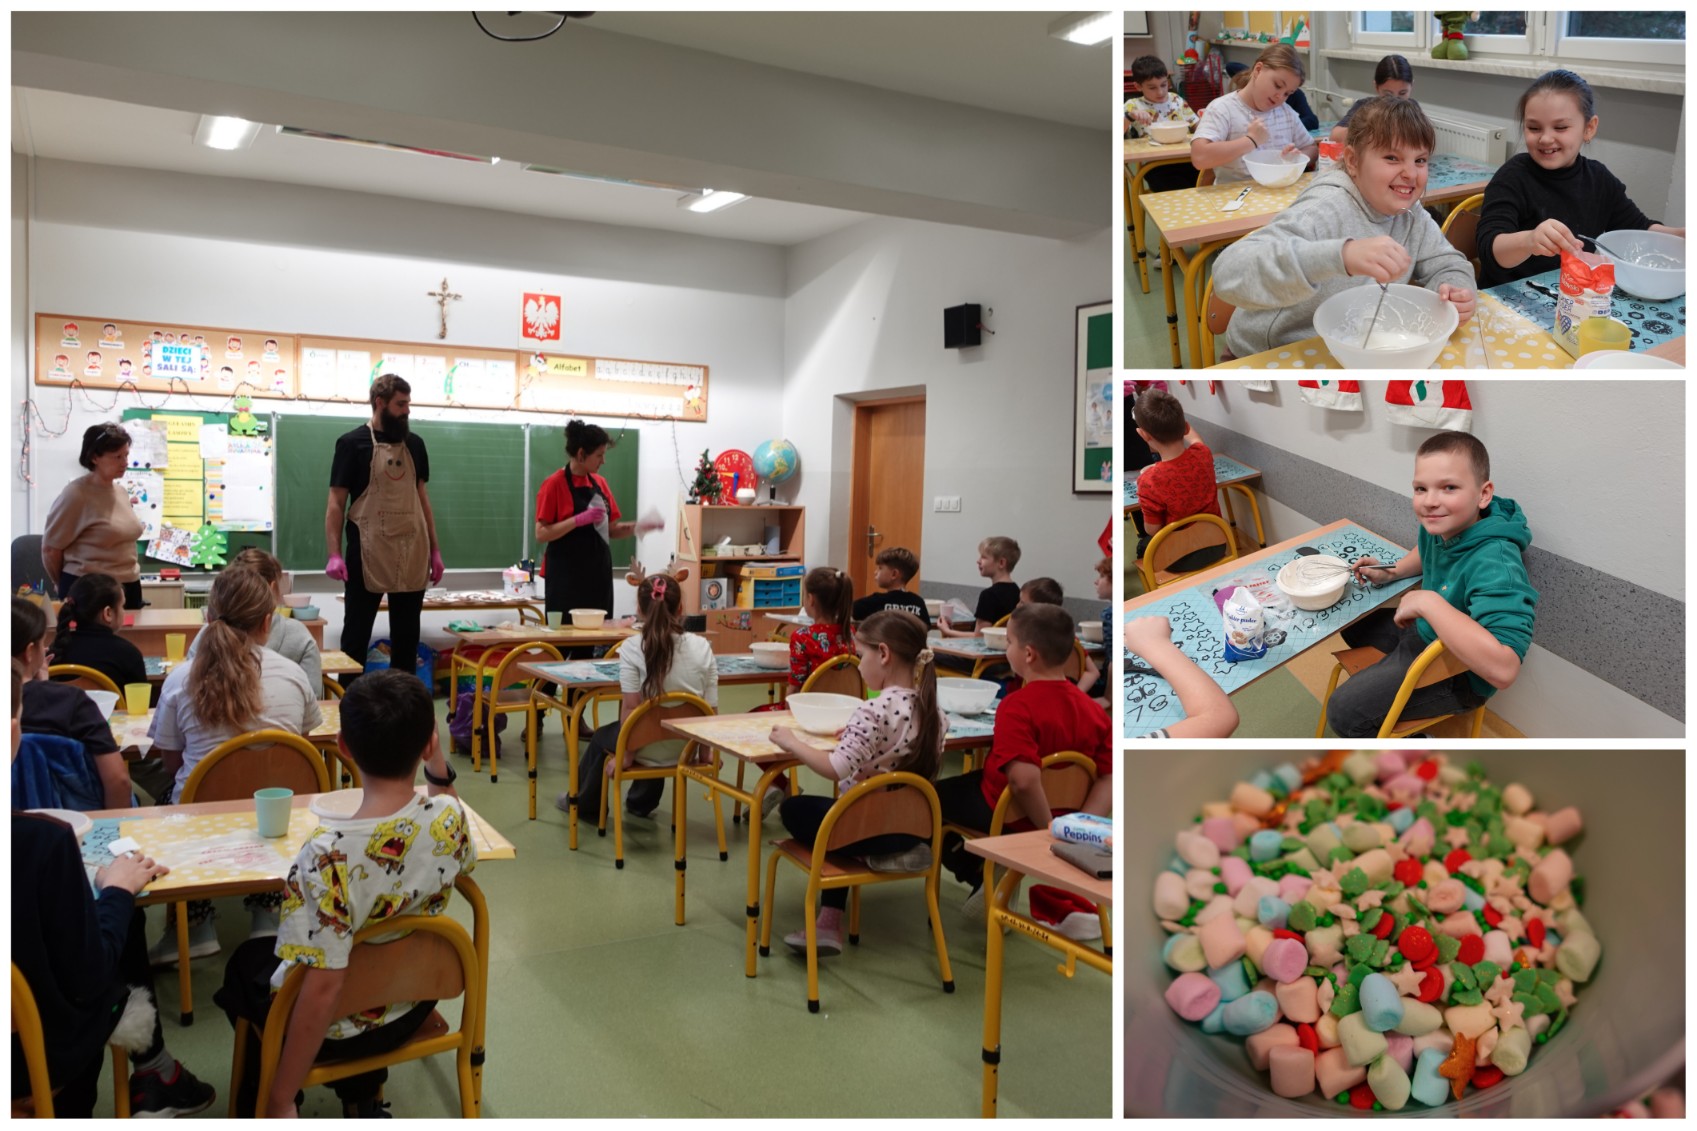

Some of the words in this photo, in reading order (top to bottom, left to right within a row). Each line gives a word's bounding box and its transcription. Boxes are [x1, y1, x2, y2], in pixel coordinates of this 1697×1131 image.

[162, 346, 191, 355] DZIECI
[175, 356, 191, 364] TEJ
[157, 363, 177, 371] SALI
[553, 363, 581, 372] Alfabet
[718, 463, 726, 471] 10
[1063, 826, 1102, 843] Peppins
